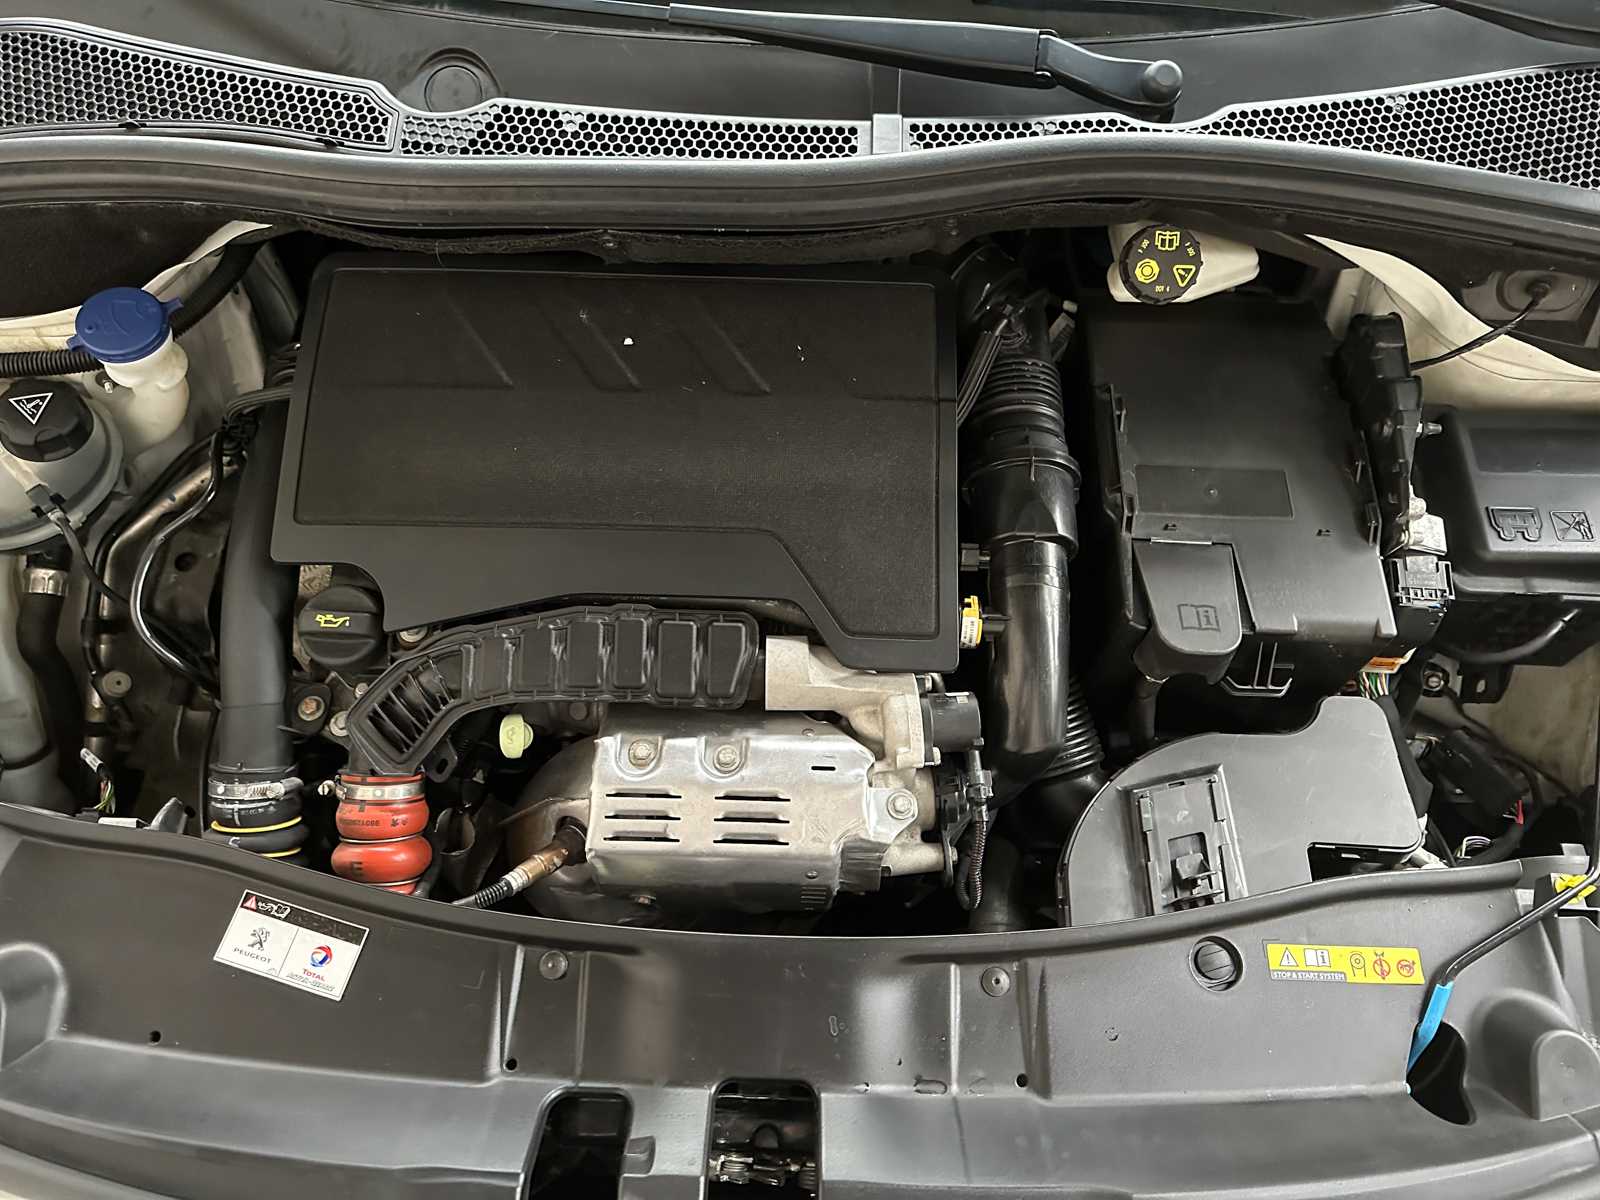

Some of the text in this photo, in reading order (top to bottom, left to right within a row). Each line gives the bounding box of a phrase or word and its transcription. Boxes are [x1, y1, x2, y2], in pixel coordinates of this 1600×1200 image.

[233, 947, 272, 964] PEUGEOT
[303, 968, 326, 982] TOTAL
[1273, 971, 1291, 979] STOP
[1298, 972, 1318, 980] START
